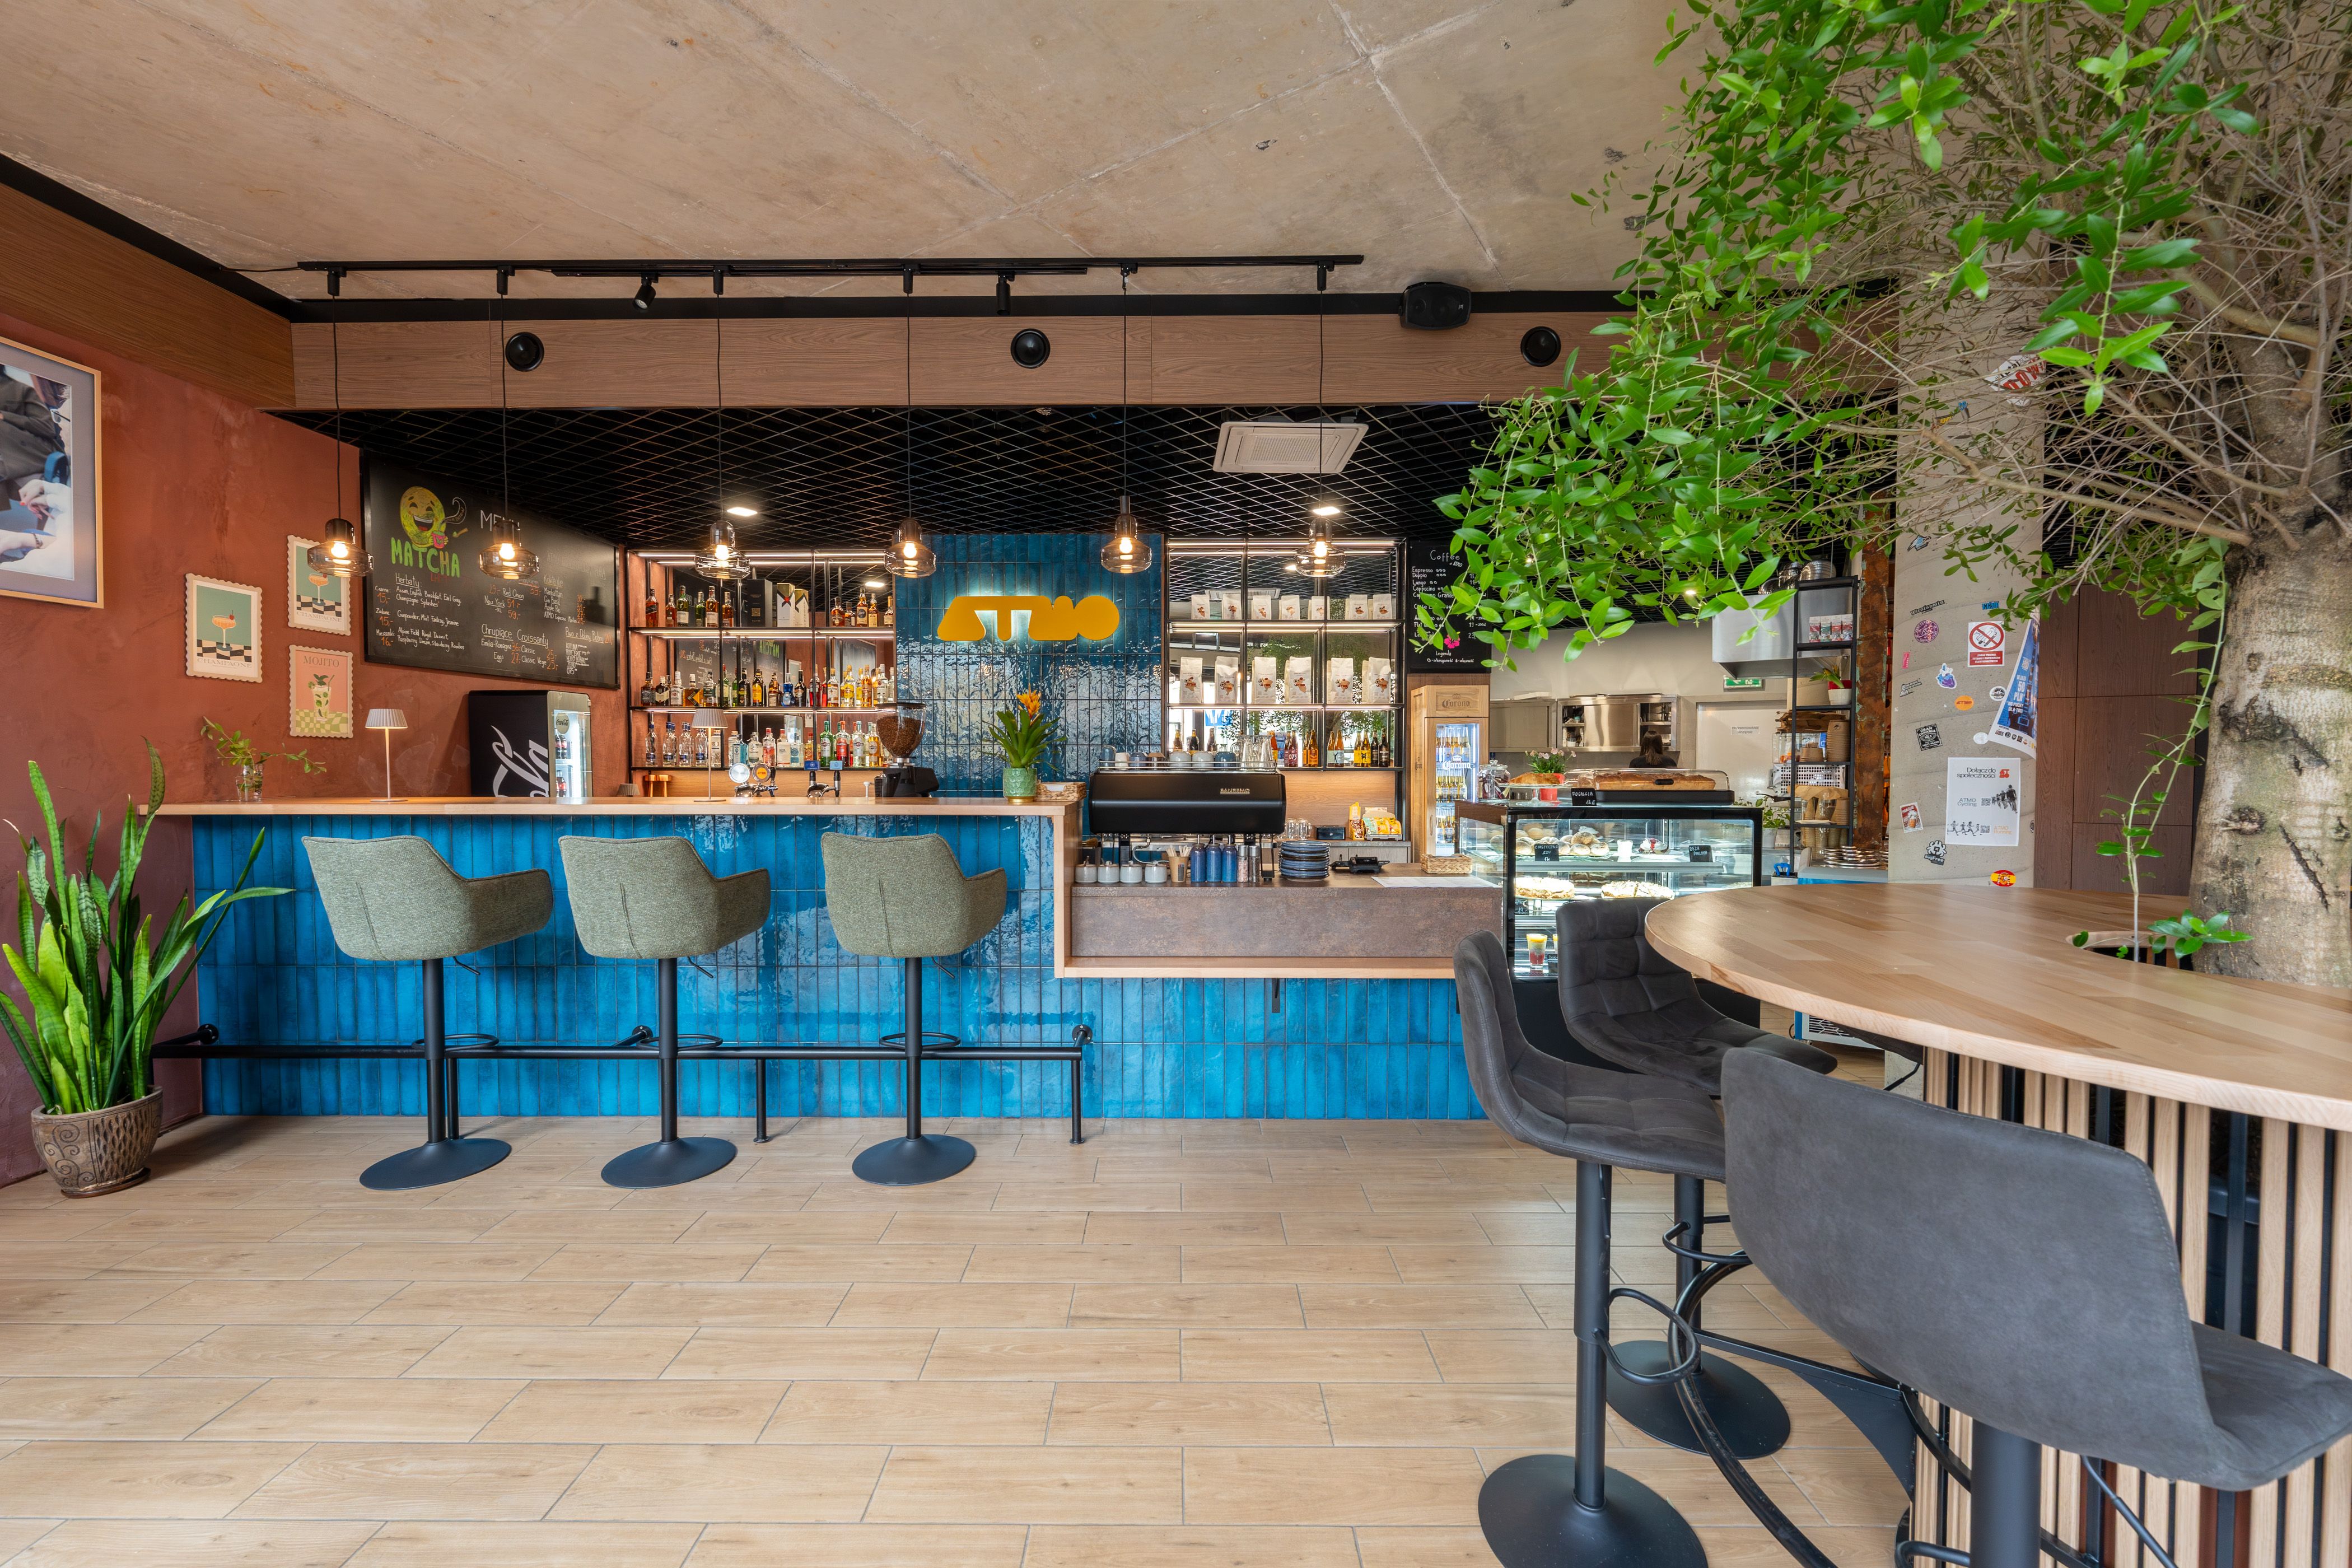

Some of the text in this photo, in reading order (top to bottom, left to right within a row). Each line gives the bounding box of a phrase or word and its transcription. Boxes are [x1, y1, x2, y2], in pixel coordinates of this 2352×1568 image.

[391, 537, 460, 578] MATCHA
[1430, 550, 1460, 562] Coffee
[503, 587, 524, 599] Red Onion
[544, 587, 563, 598] Manhattan
[396, 594, 419, 605] Champagne
[484, 595, 493, 605] New
[495, 598, 505, 608] York
[544, 603, 554, 612] Apple
[445, 617, 459, 627] Jasmine
[937, 595, 1120, 641] ATMO
[398, 627, 410, 635] Alpine
[410, 628, 419, 637] Field
[422, 630, 432, 640] Royal
[517, 629, 549, 649] Croissanty
[565, 627, 574, 637] Piwo
[592, 631, 604, 642] Bobru
[398, 635, 418, 647] Raspberry
[521, 645, 535, 654] Classic
[304, 655, 339, 667] MOJITO
[494, 652, 505, 663] Eggs
[521, 655, 536, 664] Classic
[538, 657, 547, 668] Vege
[2018, 681, 2025, 692] 50
[1442, 699, 1470, 708] Corona
[1442, 760, 1472, 770] Corona
